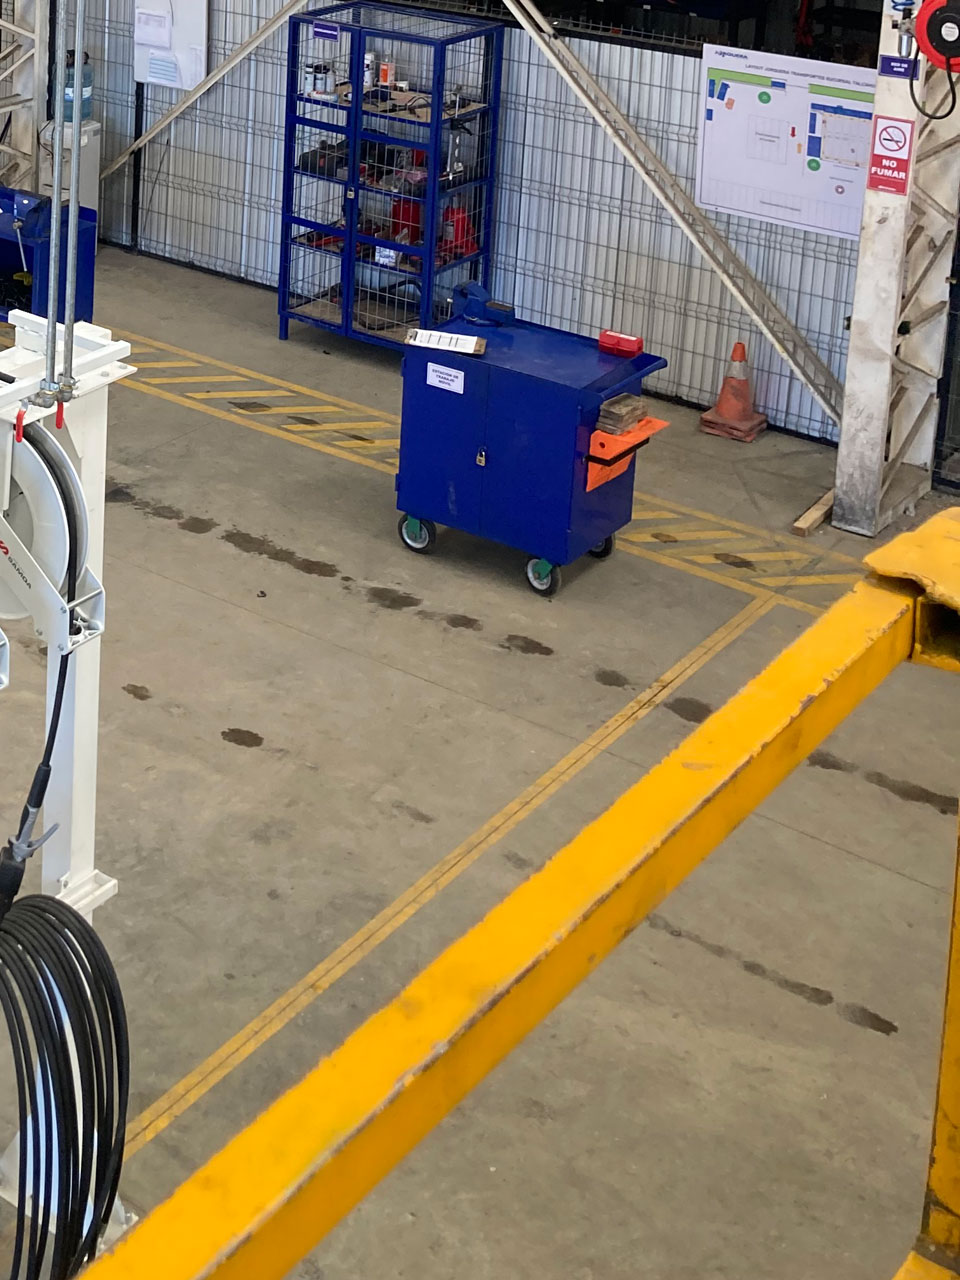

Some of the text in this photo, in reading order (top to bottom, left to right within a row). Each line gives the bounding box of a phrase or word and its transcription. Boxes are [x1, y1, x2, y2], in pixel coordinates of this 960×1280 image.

[882, 159, 897, 168] NO
[871, 167, 906, 180] FUMAR
[8, 556, 31, 589] SAMOA
